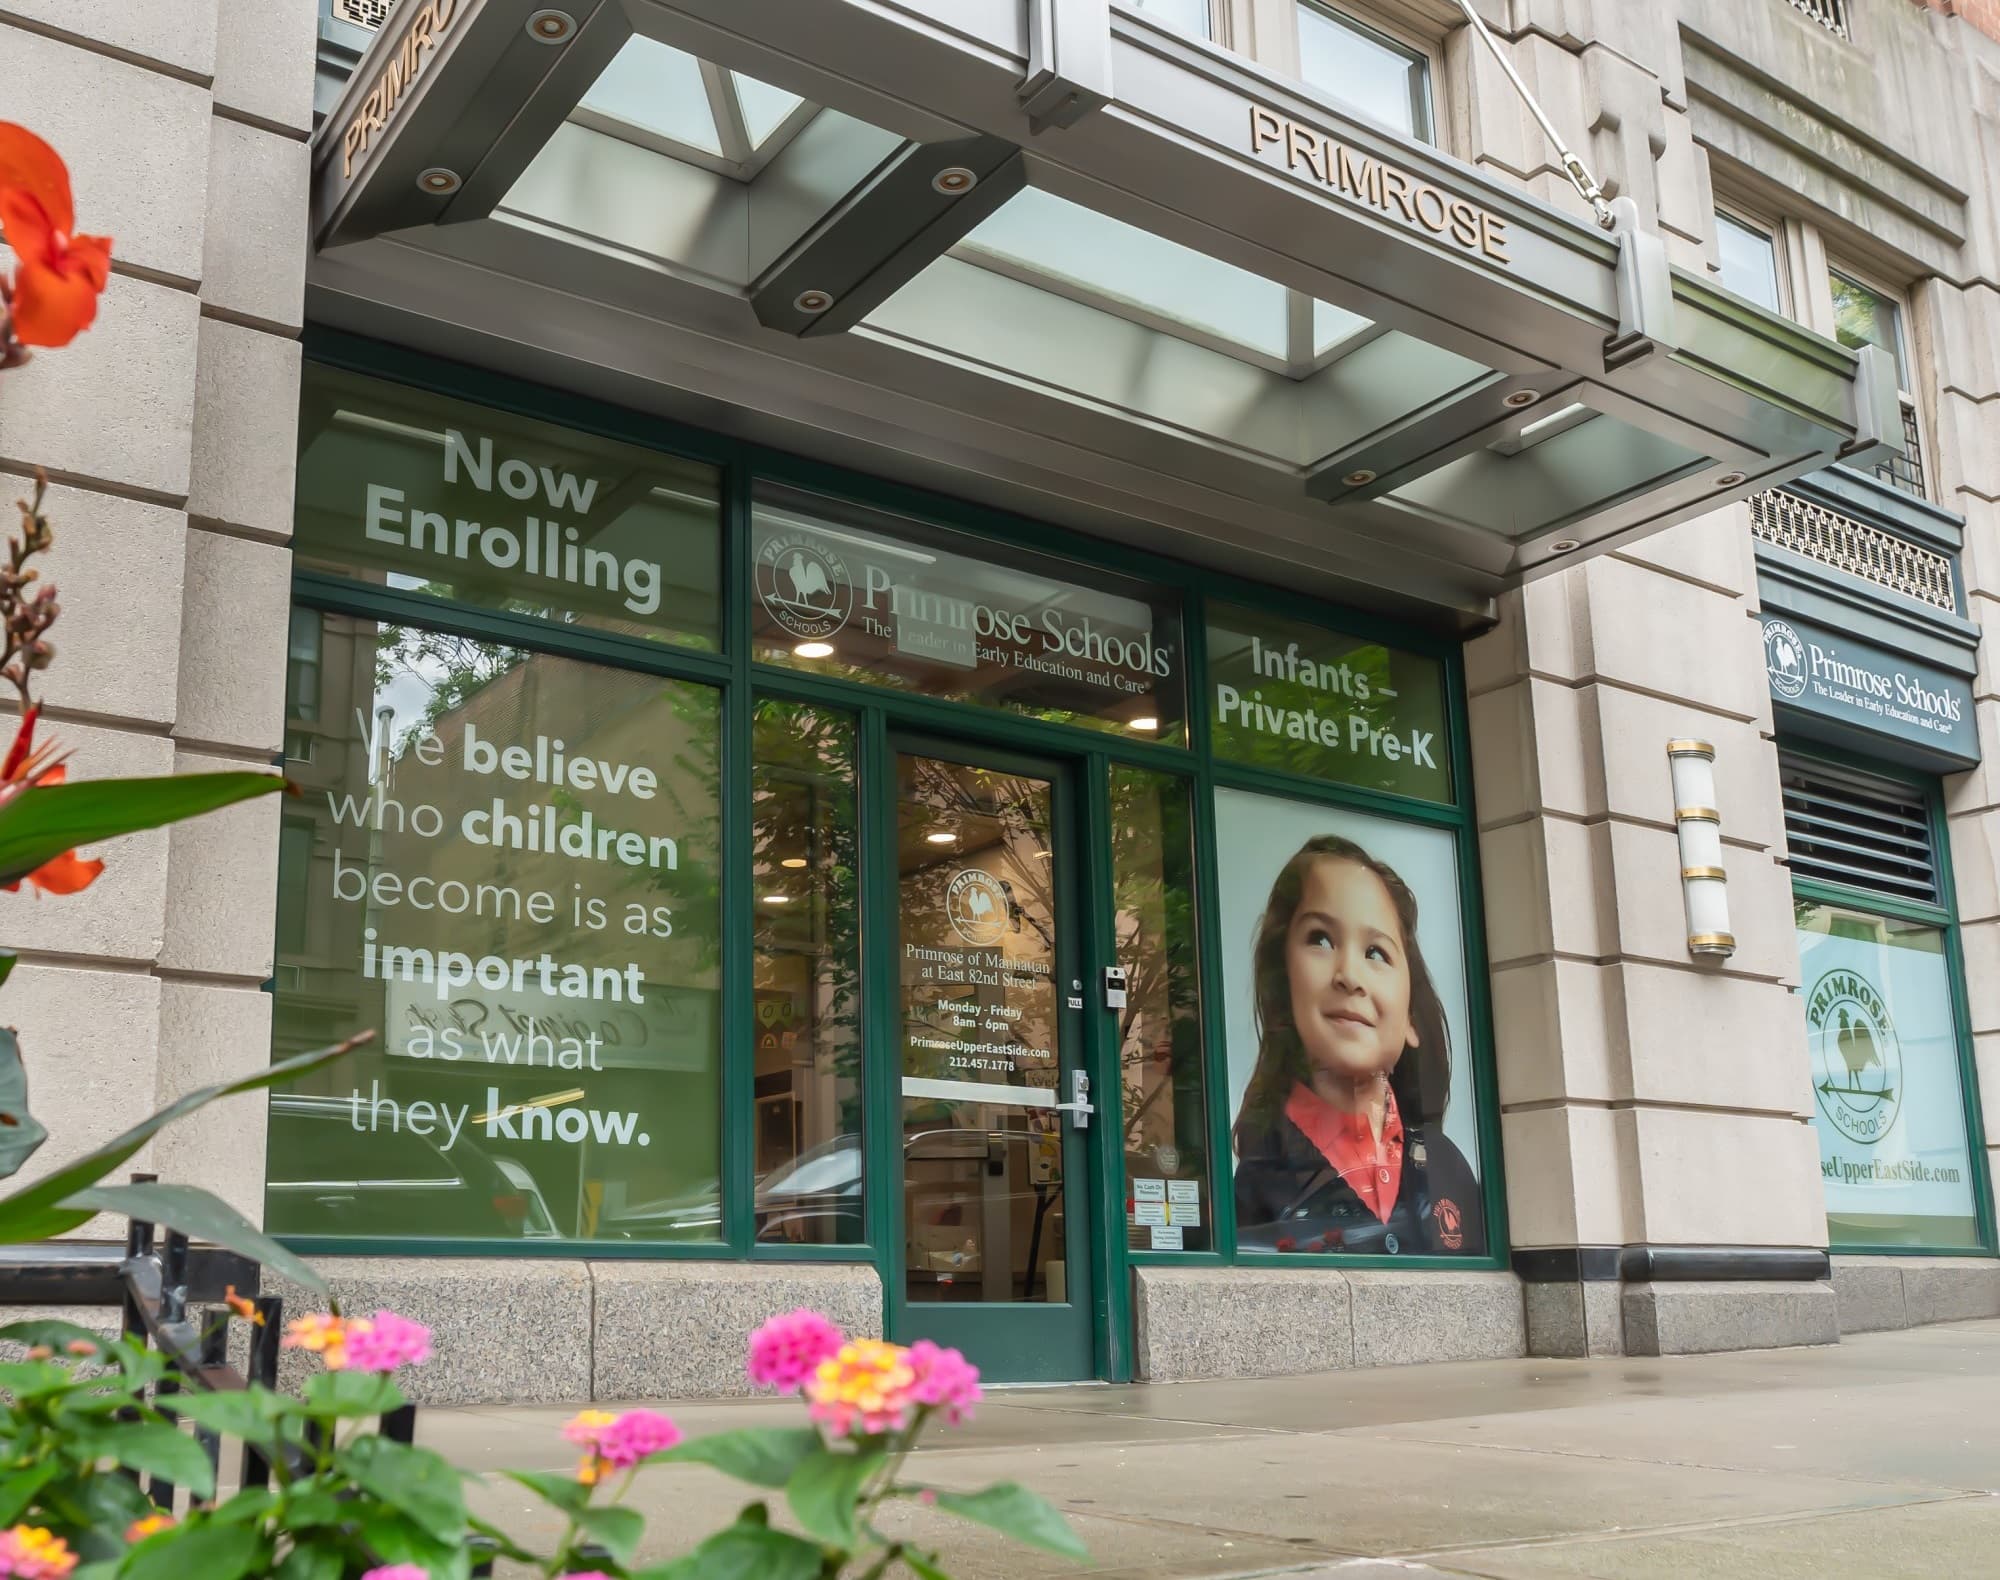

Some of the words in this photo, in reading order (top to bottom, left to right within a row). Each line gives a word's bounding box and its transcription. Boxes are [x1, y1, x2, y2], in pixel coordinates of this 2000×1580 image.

[1250, 105, 1511, 264] PRIMROSE
[444, 428, 598, 514] Now
[365, 483, 661, 615] Enrolling
[779, 610, 831, 634] SCHOOLS
[1763, 623, 1802, 652] PRIMROSE
[861, 616, 892, 638] The
[973, 641, 1009, 668] Early
[1014, 651, 1082, 681] Education
[1086, 671, 1110, 687] and
[1252, 636, 1370, 700] Infants
[1808, 643, 1893, 699] Primrose
[1217, 683, 1340, 747] Private
[1349, 715, 1437, 770] Pre-K
[1812, 680, 1828, 696] The
[1829, 685, 1854, 705] Leader
[1855, 694, 1864, 707] in
[1864, 697, 1883, 716] Early
[1885, 704, 1919, 725] Education
[1920, 718, 1933, 729] and
[464, 723, 658, 799] believe
[327, 781, 443, 837] who
[461, 798, 678, 870] children
[333, 848, 555, 924] become
[574, 883, 607, 930] is
[624, 902, 673, 937] as
[363, 928, 645, 1004] important
[906, 944, 964, 965] Primrose
[967, 950, 981, 966] of
[985, 952, 1050, 974] Manhattan
[921, 967, 933, 978] at
[938, 965, 964, 981] East
[969, 968, 999, 985] 82nd
[1002, 971, 1037, 990] Street
[937, 999, 981, 1016] Monday
[990, 1004, 1022, 1020] Friday
[953, 1015, 976, 1028] 8am
[985, 1018, 1009, 1032] 6pm
[1810, 975, 1890, 1036] PRIMROSE
[407, 1025, 463, 1061] as
[481, 1017, 604, 1071] what
[910, 1036, 1050, 1058] PrimroseUpperEastSide.com
[949, 1056, 1015, 1071] 212.457.1778
[351, 1080, 469, 1151] they
[486, 1087, 651, 1146] know.
[1836, 1106, 1888, 1136] SCHOOLS
